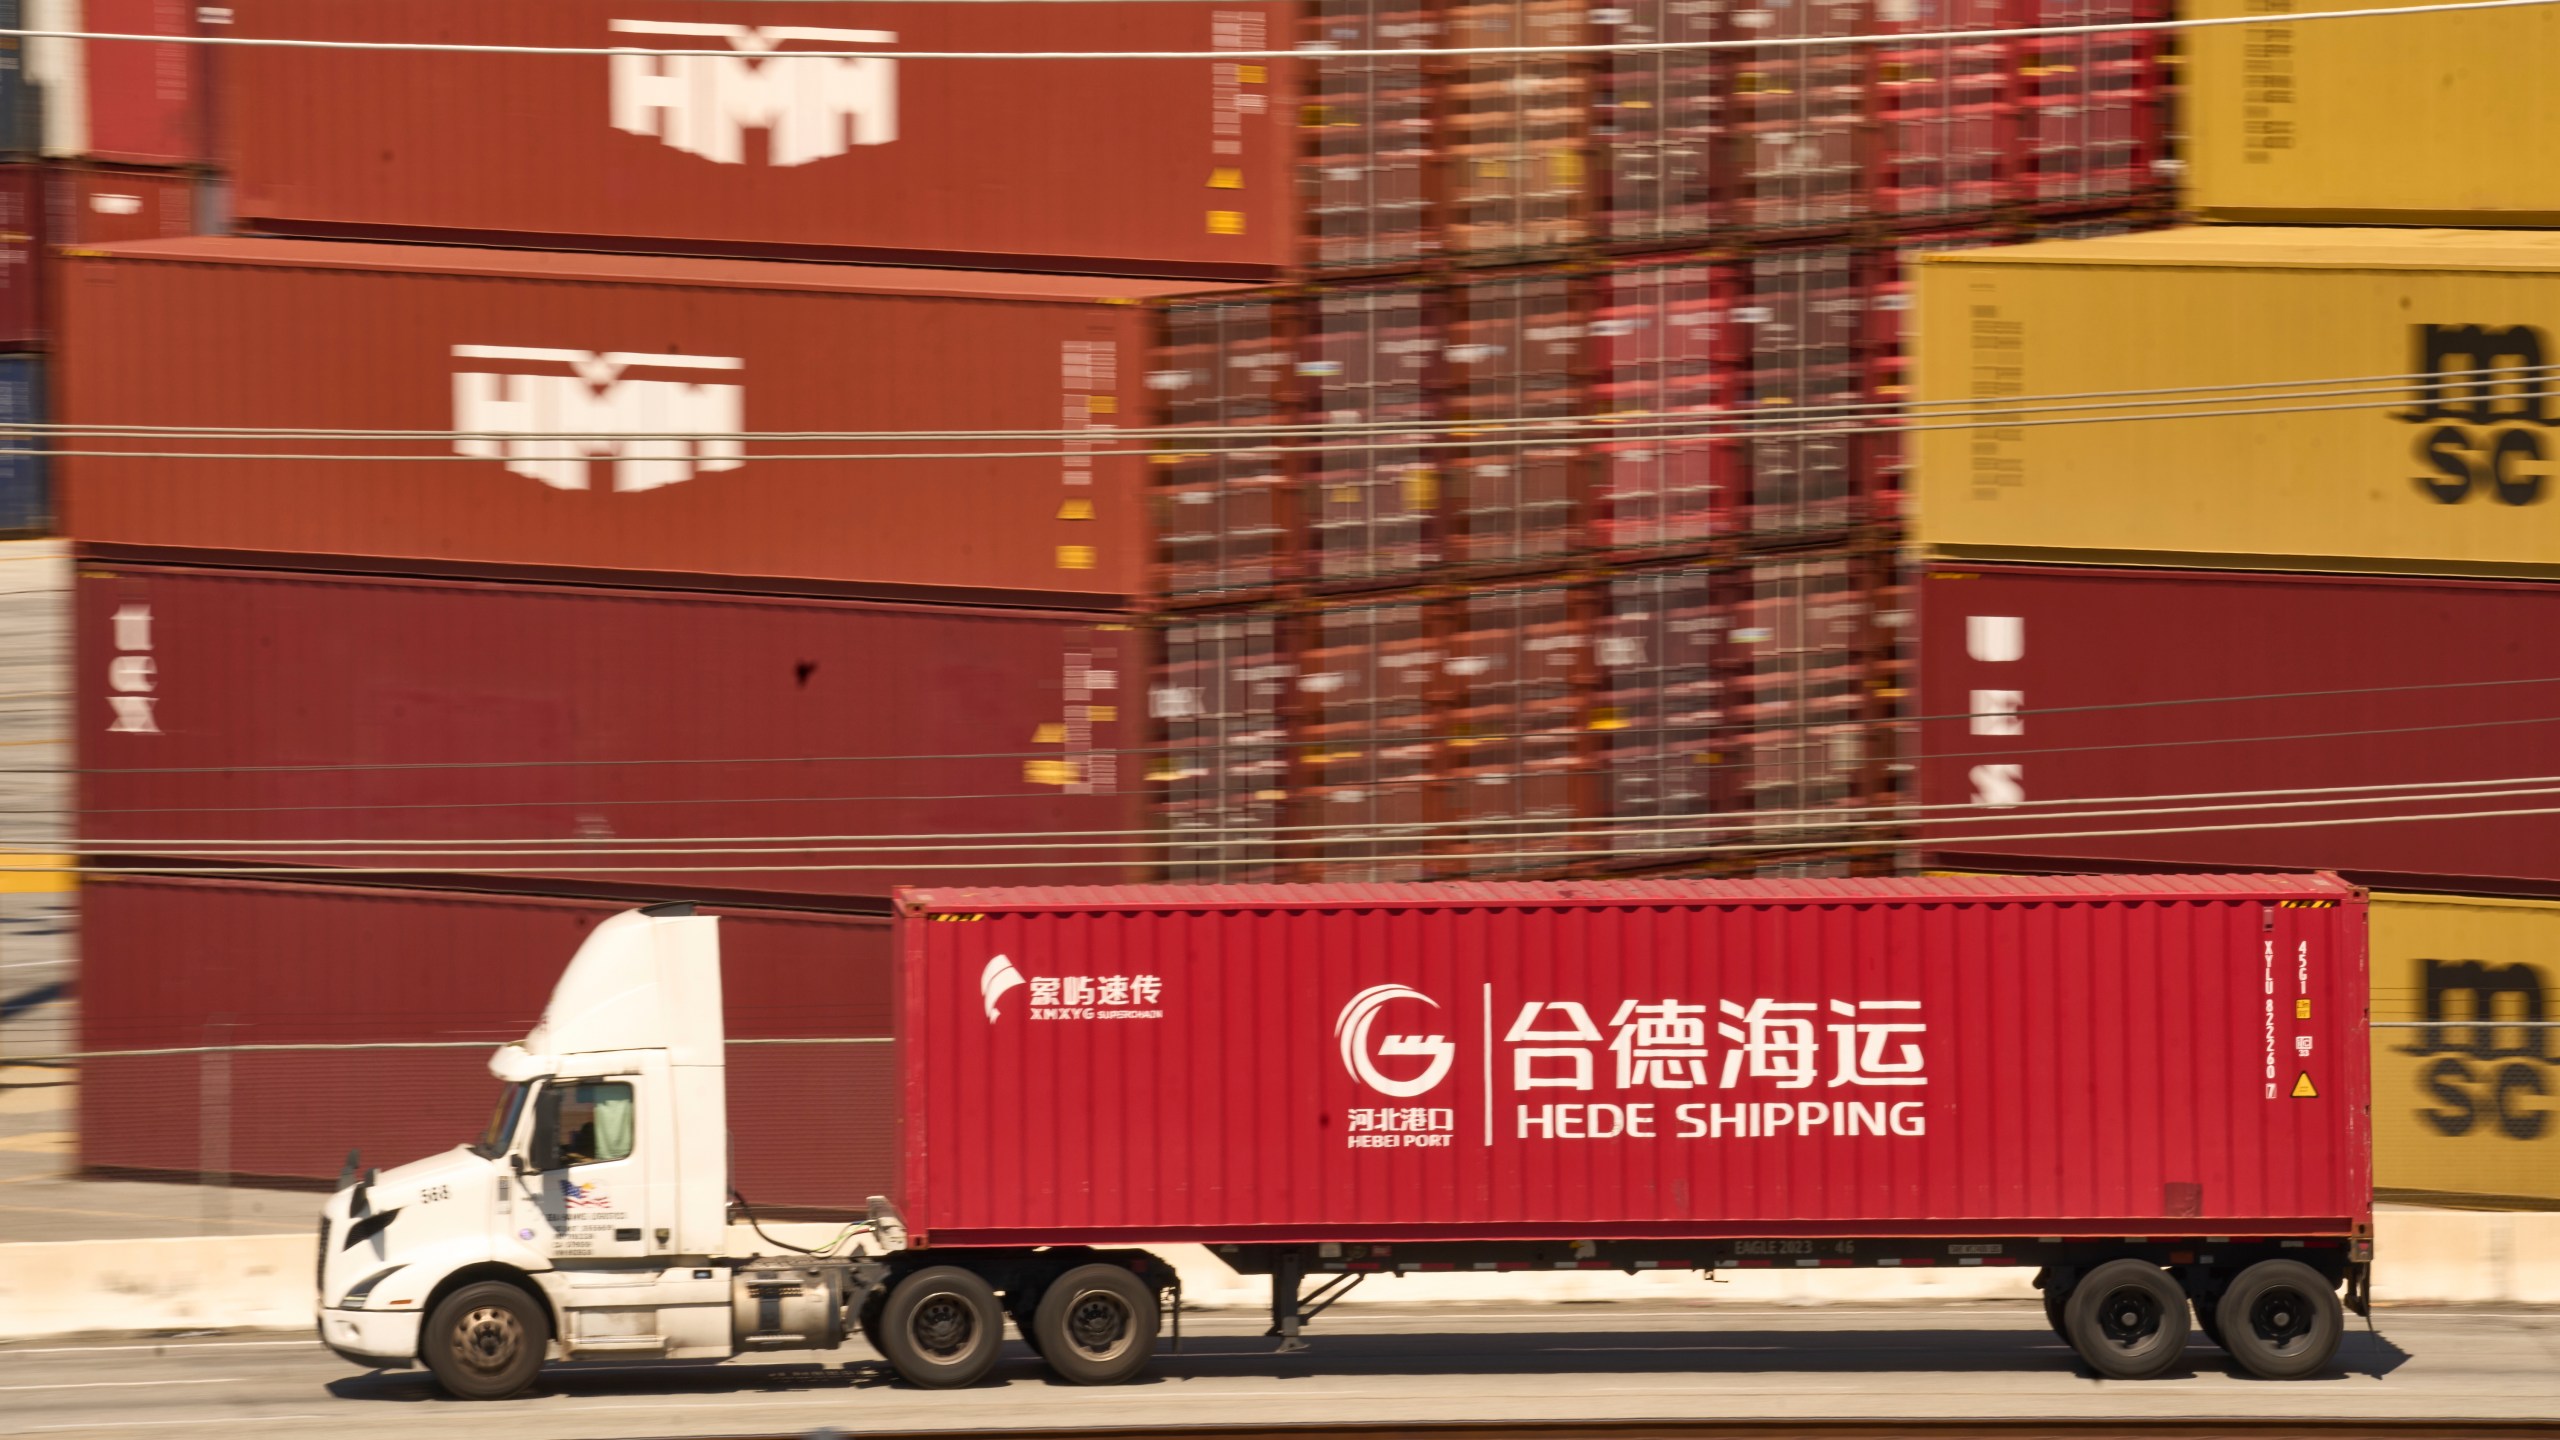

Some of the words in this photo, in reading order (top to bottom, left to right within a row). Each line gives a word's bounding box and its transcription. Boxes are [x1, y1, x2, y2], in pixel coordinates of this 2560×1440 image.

[1966, 616, 2025, 809] UES
[2264, 940, 2274, 995] XYLU
[2298, 940, 2308, 995] 45G1
[1030, 1007, 1095, 1020] XMXYG
[1504, 998, 1928, 1091] 合德海运
[2266, 998, 2275, 1079] 822260
[1347, 1107, 1454, 1132] 河北港口
[1347, 1135, 1400, 1148] HEBEI
[1403, 1134, 1454, 1147] PORT
[1517, 1102, 1657, 1139] HEDE
[1675, 1101, 1926, 1139] SHIPPING
[1734, 1241, 1777, 1254] EAGLE
